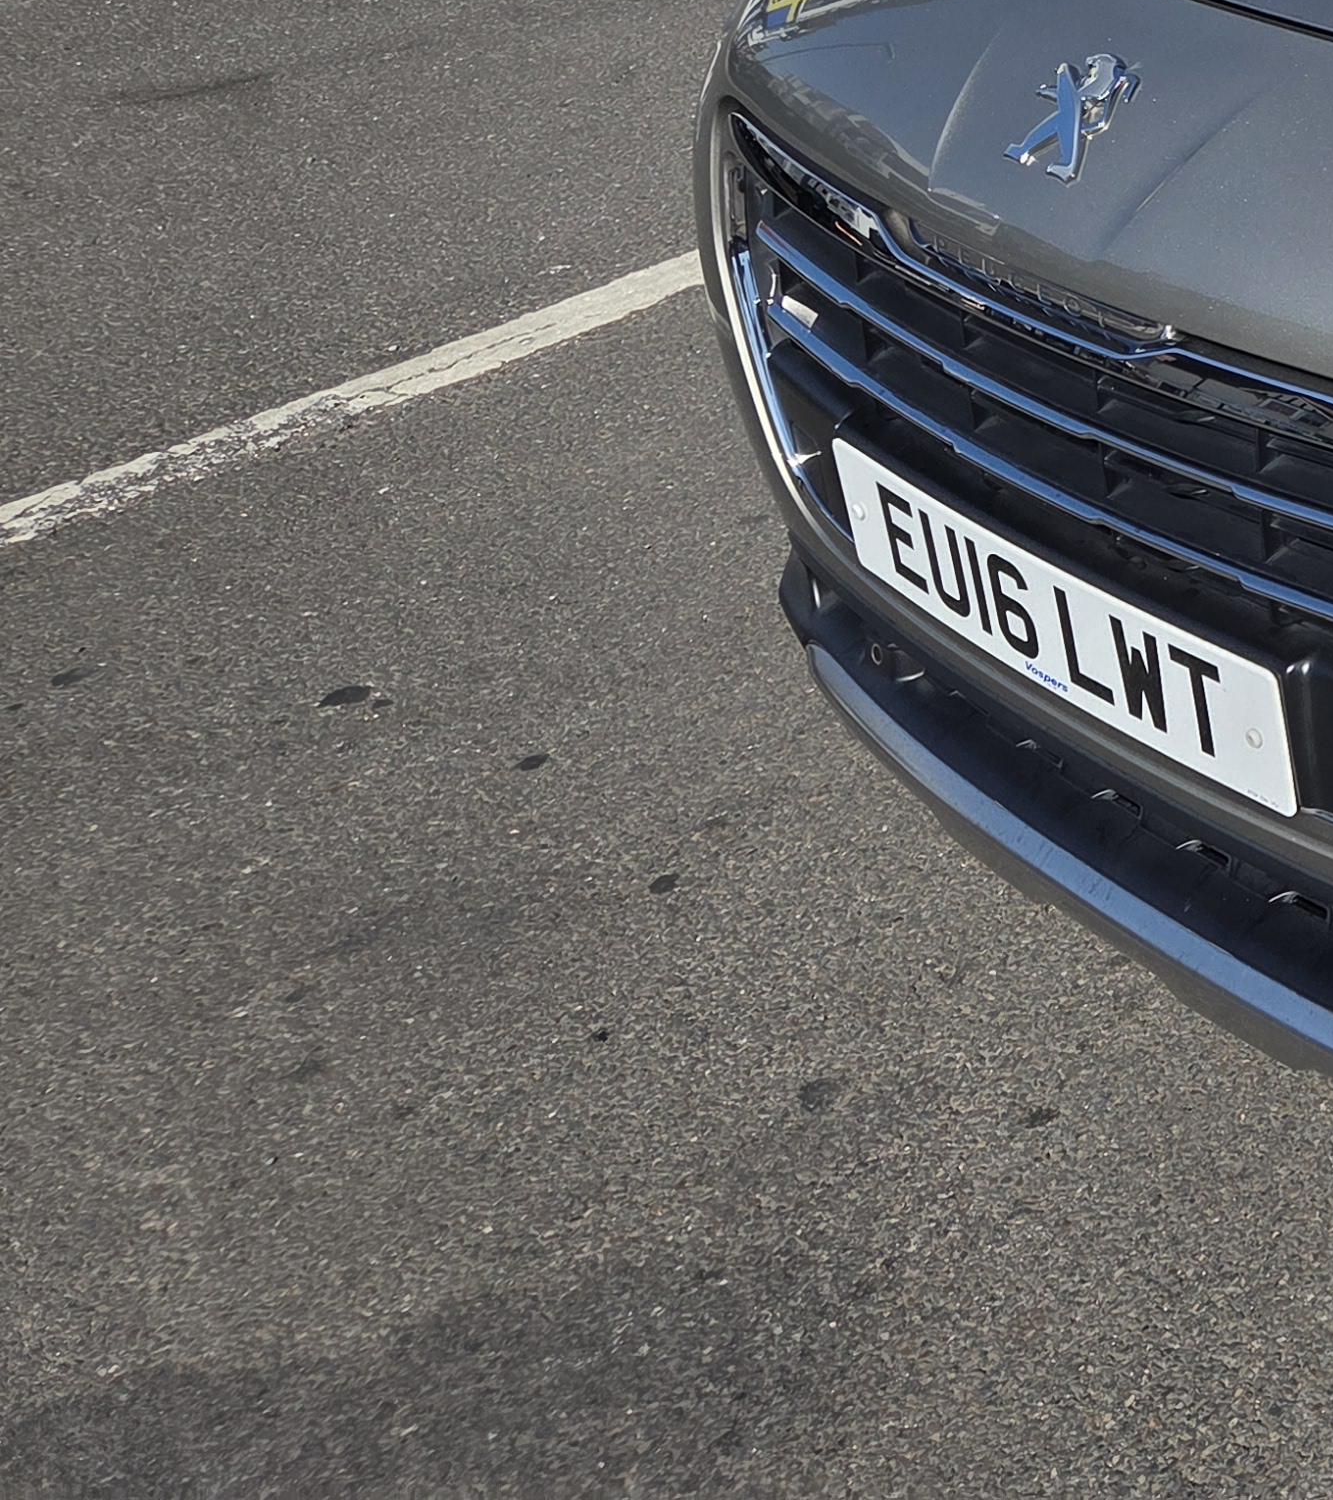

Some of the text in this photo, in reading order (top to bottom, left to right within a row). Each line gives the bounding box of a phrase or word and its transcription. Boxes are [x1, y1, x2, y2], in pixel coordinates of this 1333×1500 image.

[875, 480, 1221, 758] EU16 LWT
[1025, 661, 1068, 692] Vospers
